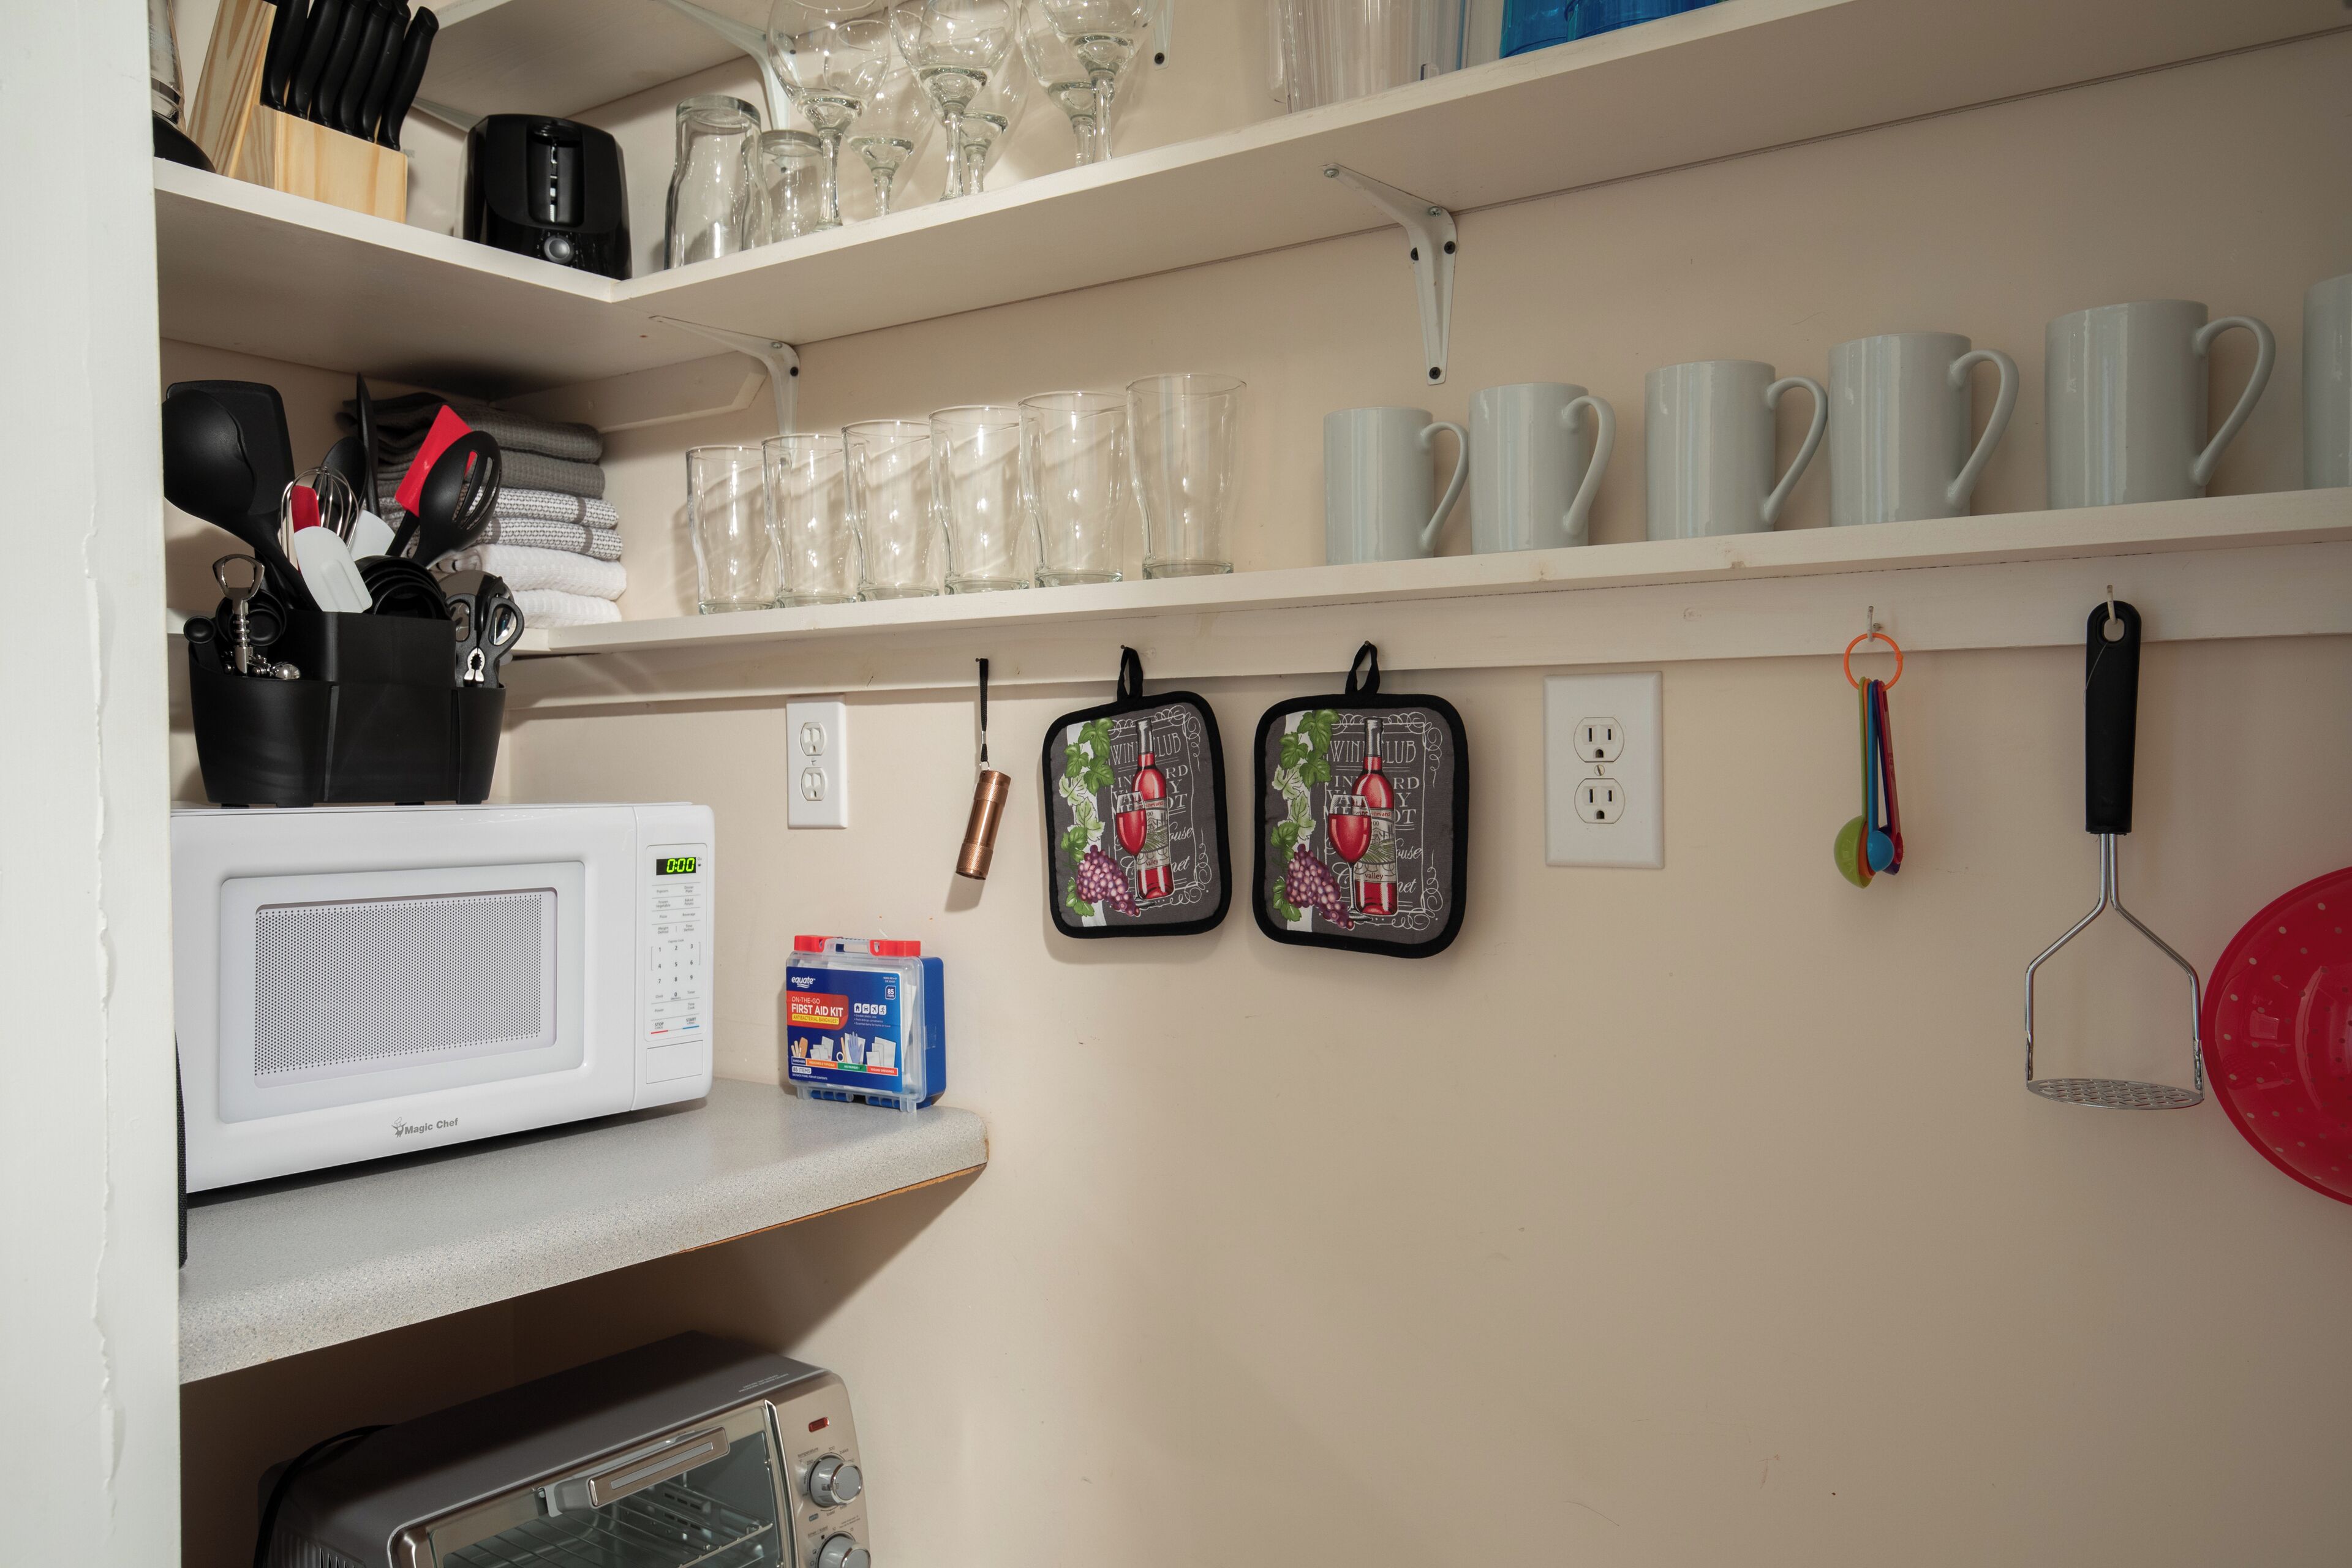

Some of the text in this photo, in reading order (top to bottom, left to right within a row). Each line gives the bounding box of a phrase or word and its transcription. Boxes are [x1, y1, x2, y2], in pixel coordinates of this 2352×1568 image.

[1110, 733, 1181, 766] WIN LUB
[1330, 741, 1417, 764] WIN LUB
[666, 858, 695, 873] 0:00
[1365, 872, 1384, 881] valley
[791, 976, 814, 986] equate
[791, 996, 820, 1005] ON-THE-GO
[791, 1003, 843, 1017] FIRST AID KIT
[405, 1118, 458, 1134] Magic Chef
